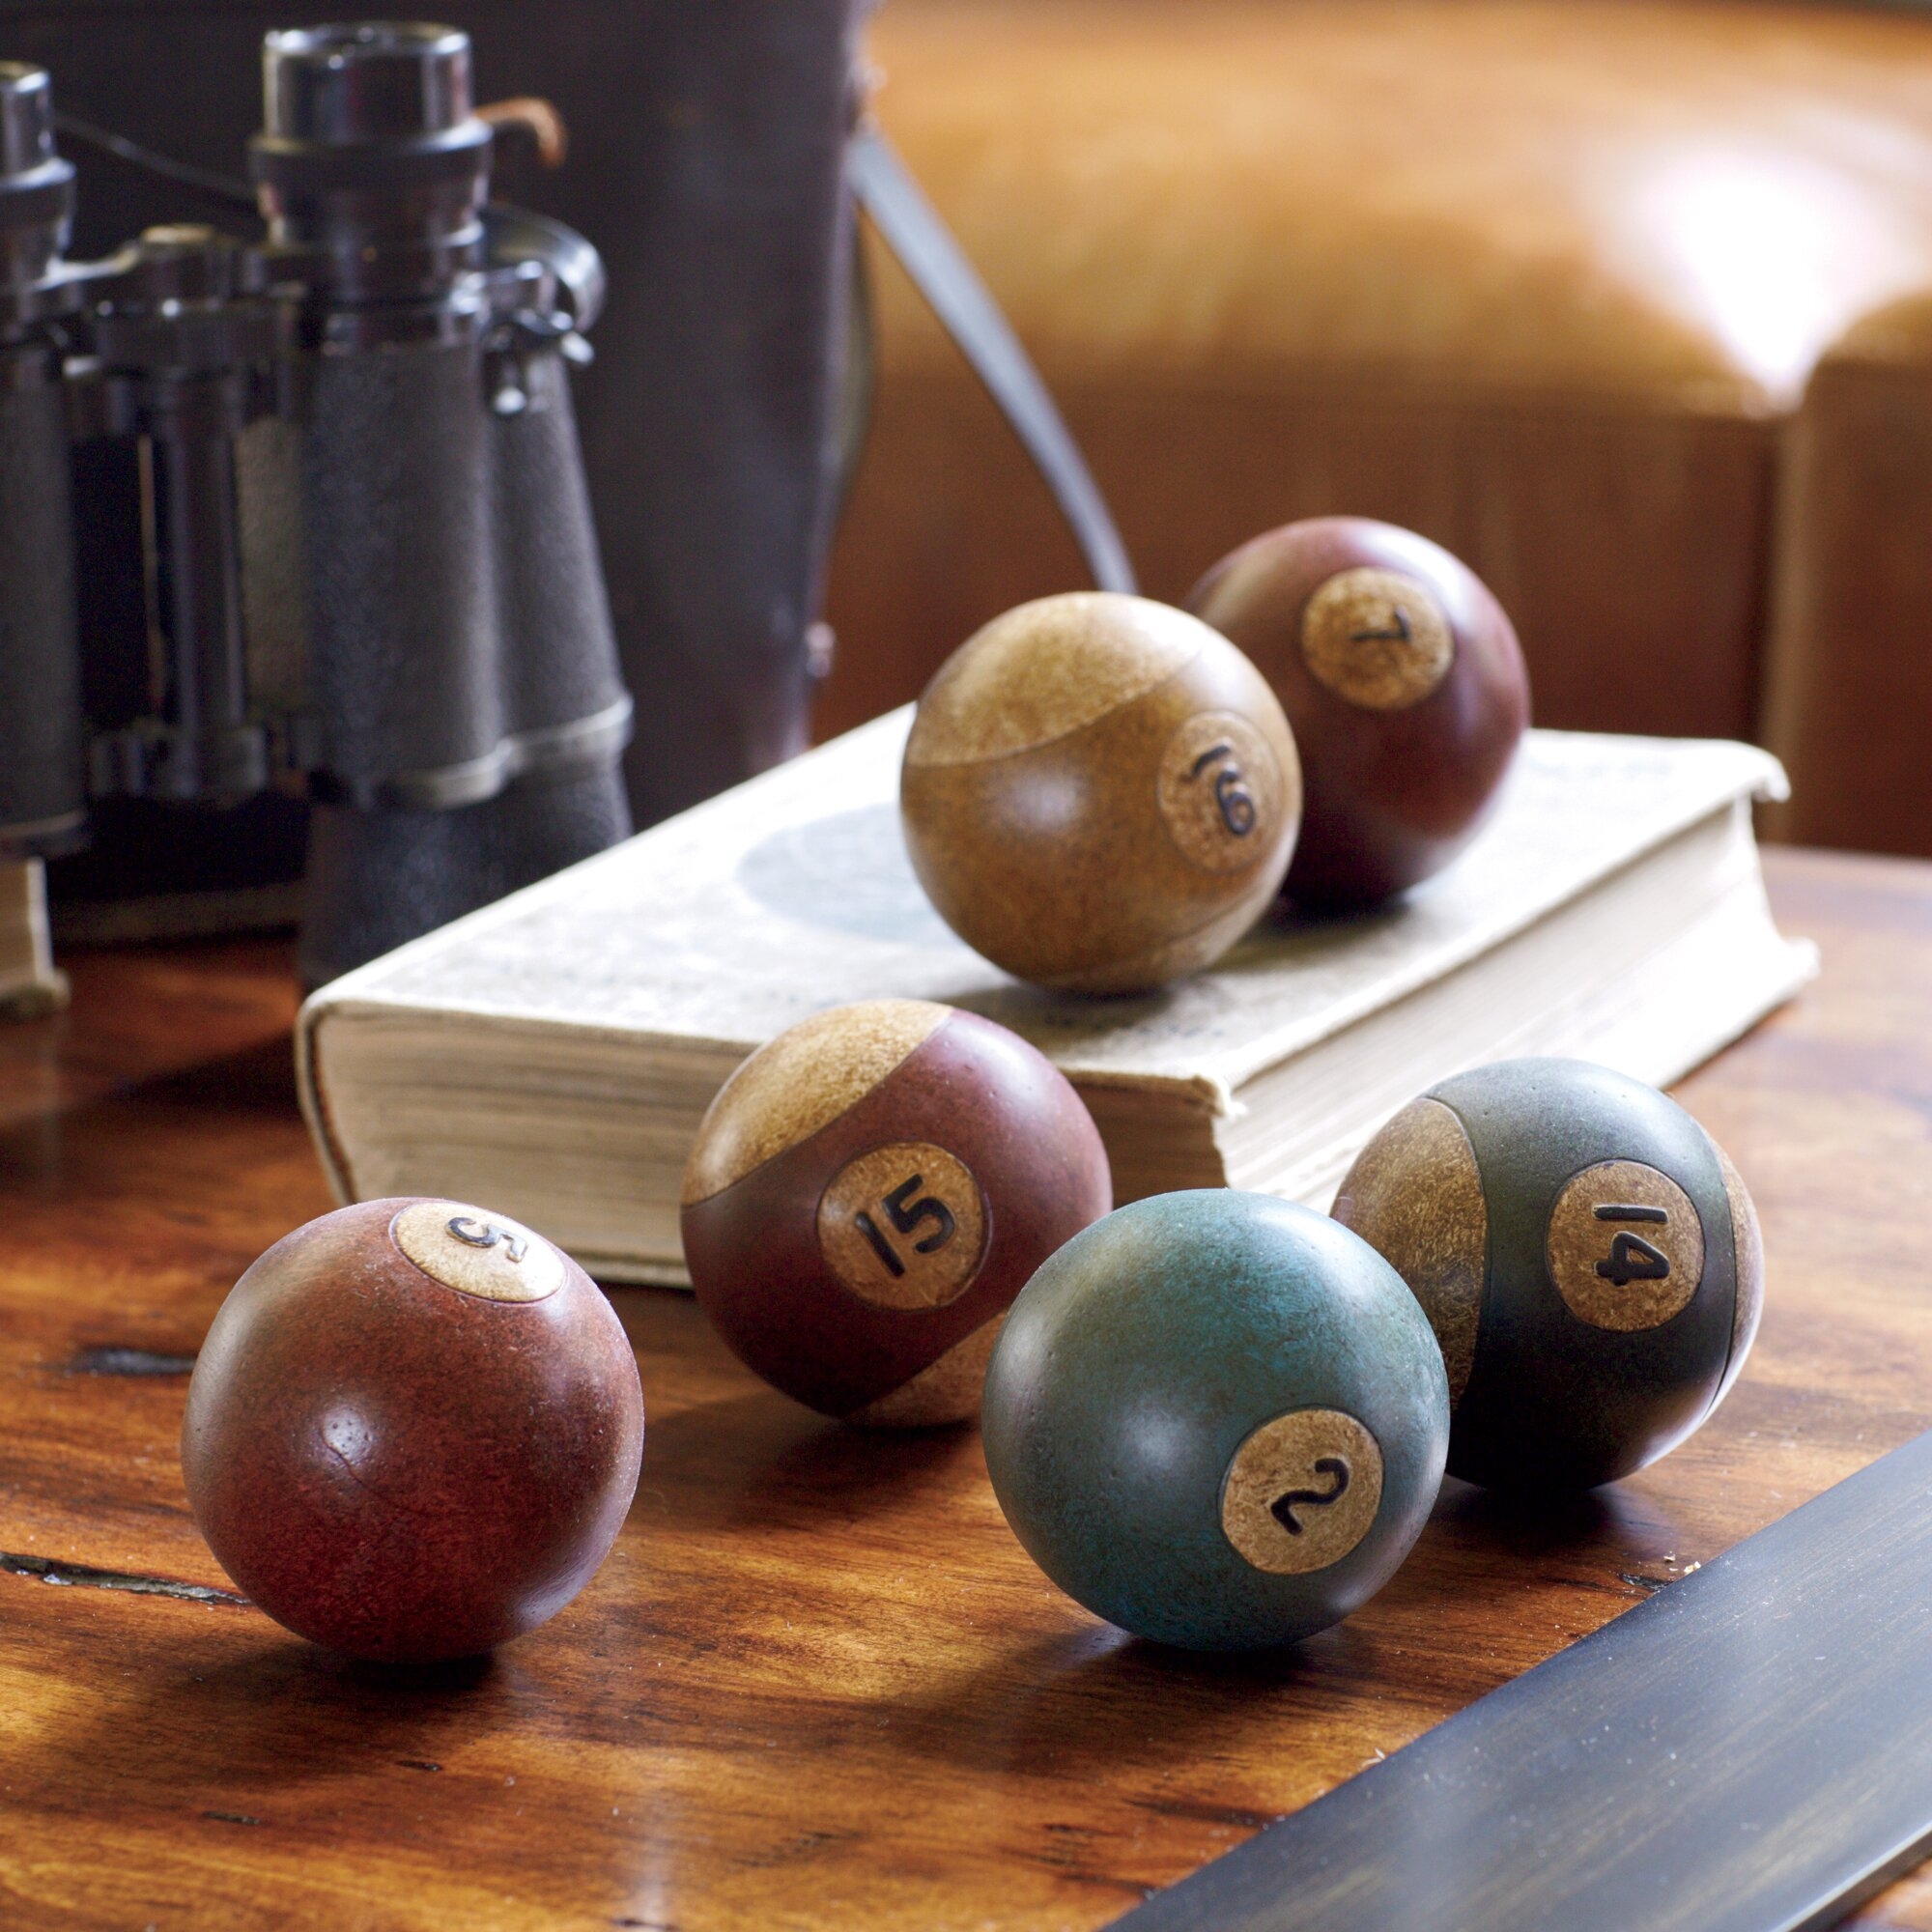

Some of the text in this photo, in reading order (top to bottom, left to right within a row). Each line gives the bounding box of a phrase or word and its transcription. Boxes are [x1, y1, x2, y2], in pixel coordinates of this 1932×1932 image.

[446, 1217, 529, 1263] 5
[856, 1174, 954, 1277] 15
[1593, 1206, 1670, 1287] 14
[1270, 1458, 1350, 1536] 2
